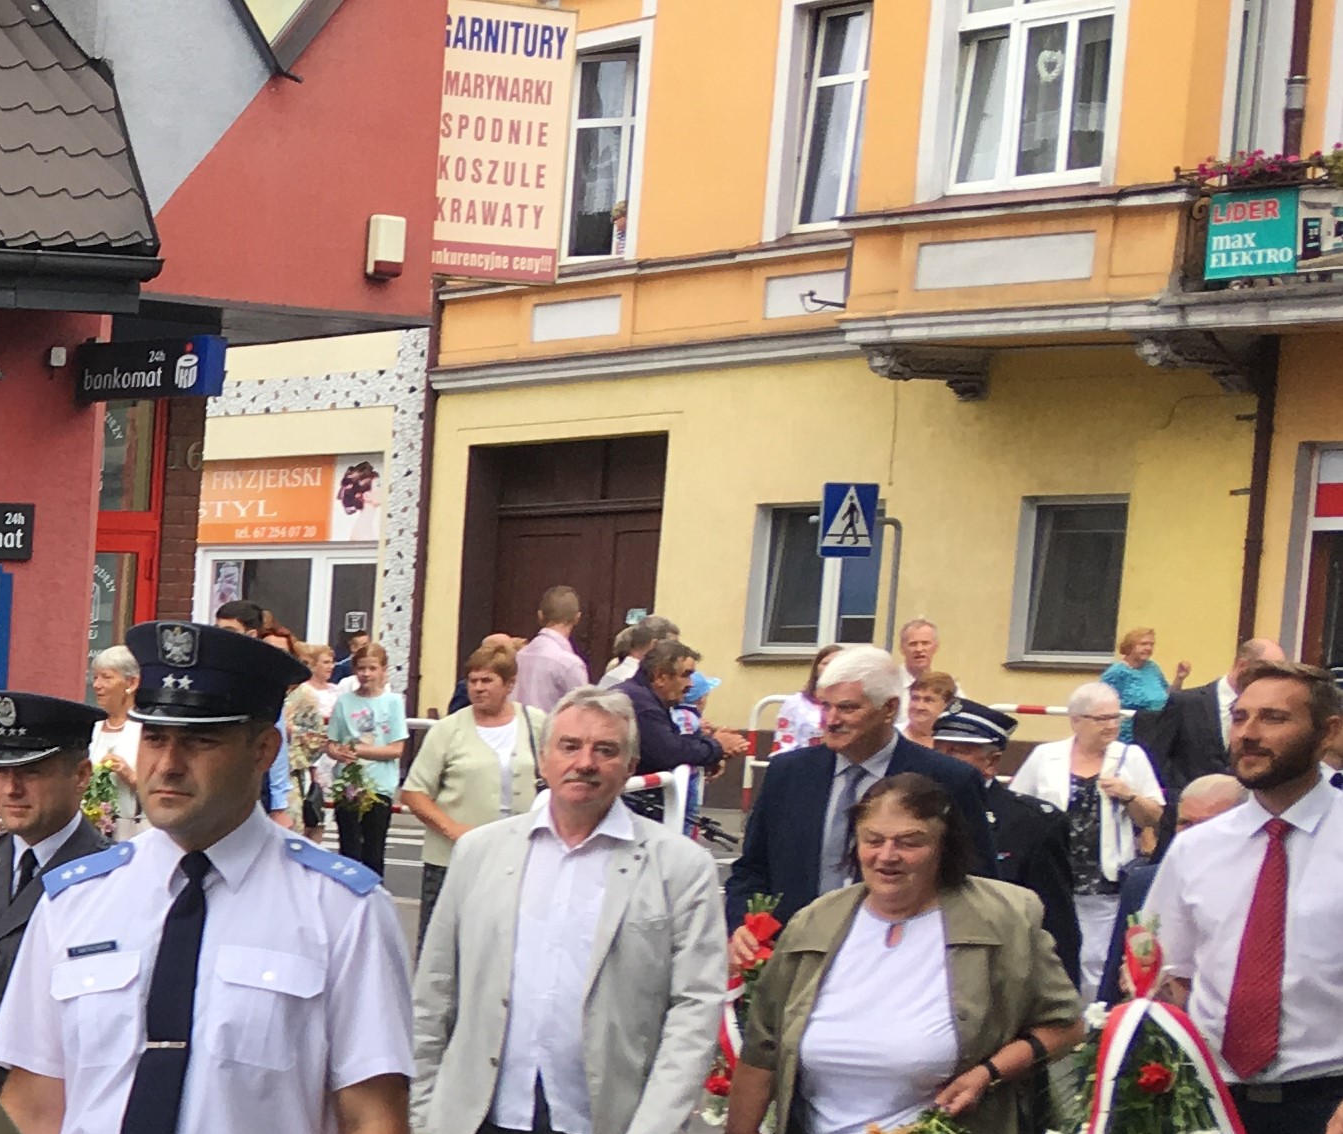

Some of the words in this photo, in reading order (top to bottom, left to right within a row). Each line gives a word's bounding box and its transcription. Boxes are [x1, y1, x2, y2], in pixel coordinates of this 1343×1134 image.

[444, 70, 553, 106] MARYNARKI
[440, 112, 549, 147] SPODNIE
[437, 154, 547, 189] KOSZULE
[435, 196, 544, 230] KRAWATY
[1212, 198, 1280, 225] LIDER
[1212, 232, 1257, 251] max
[1209, 247, 1293, 268] ELEKTRO
[148, 351, 166, 364] 24h
[83, 367, 163, 390] bankomat
[212, 466, 323, 493] FRYZJERSKI
[5, 512, 25, 525] 24h
